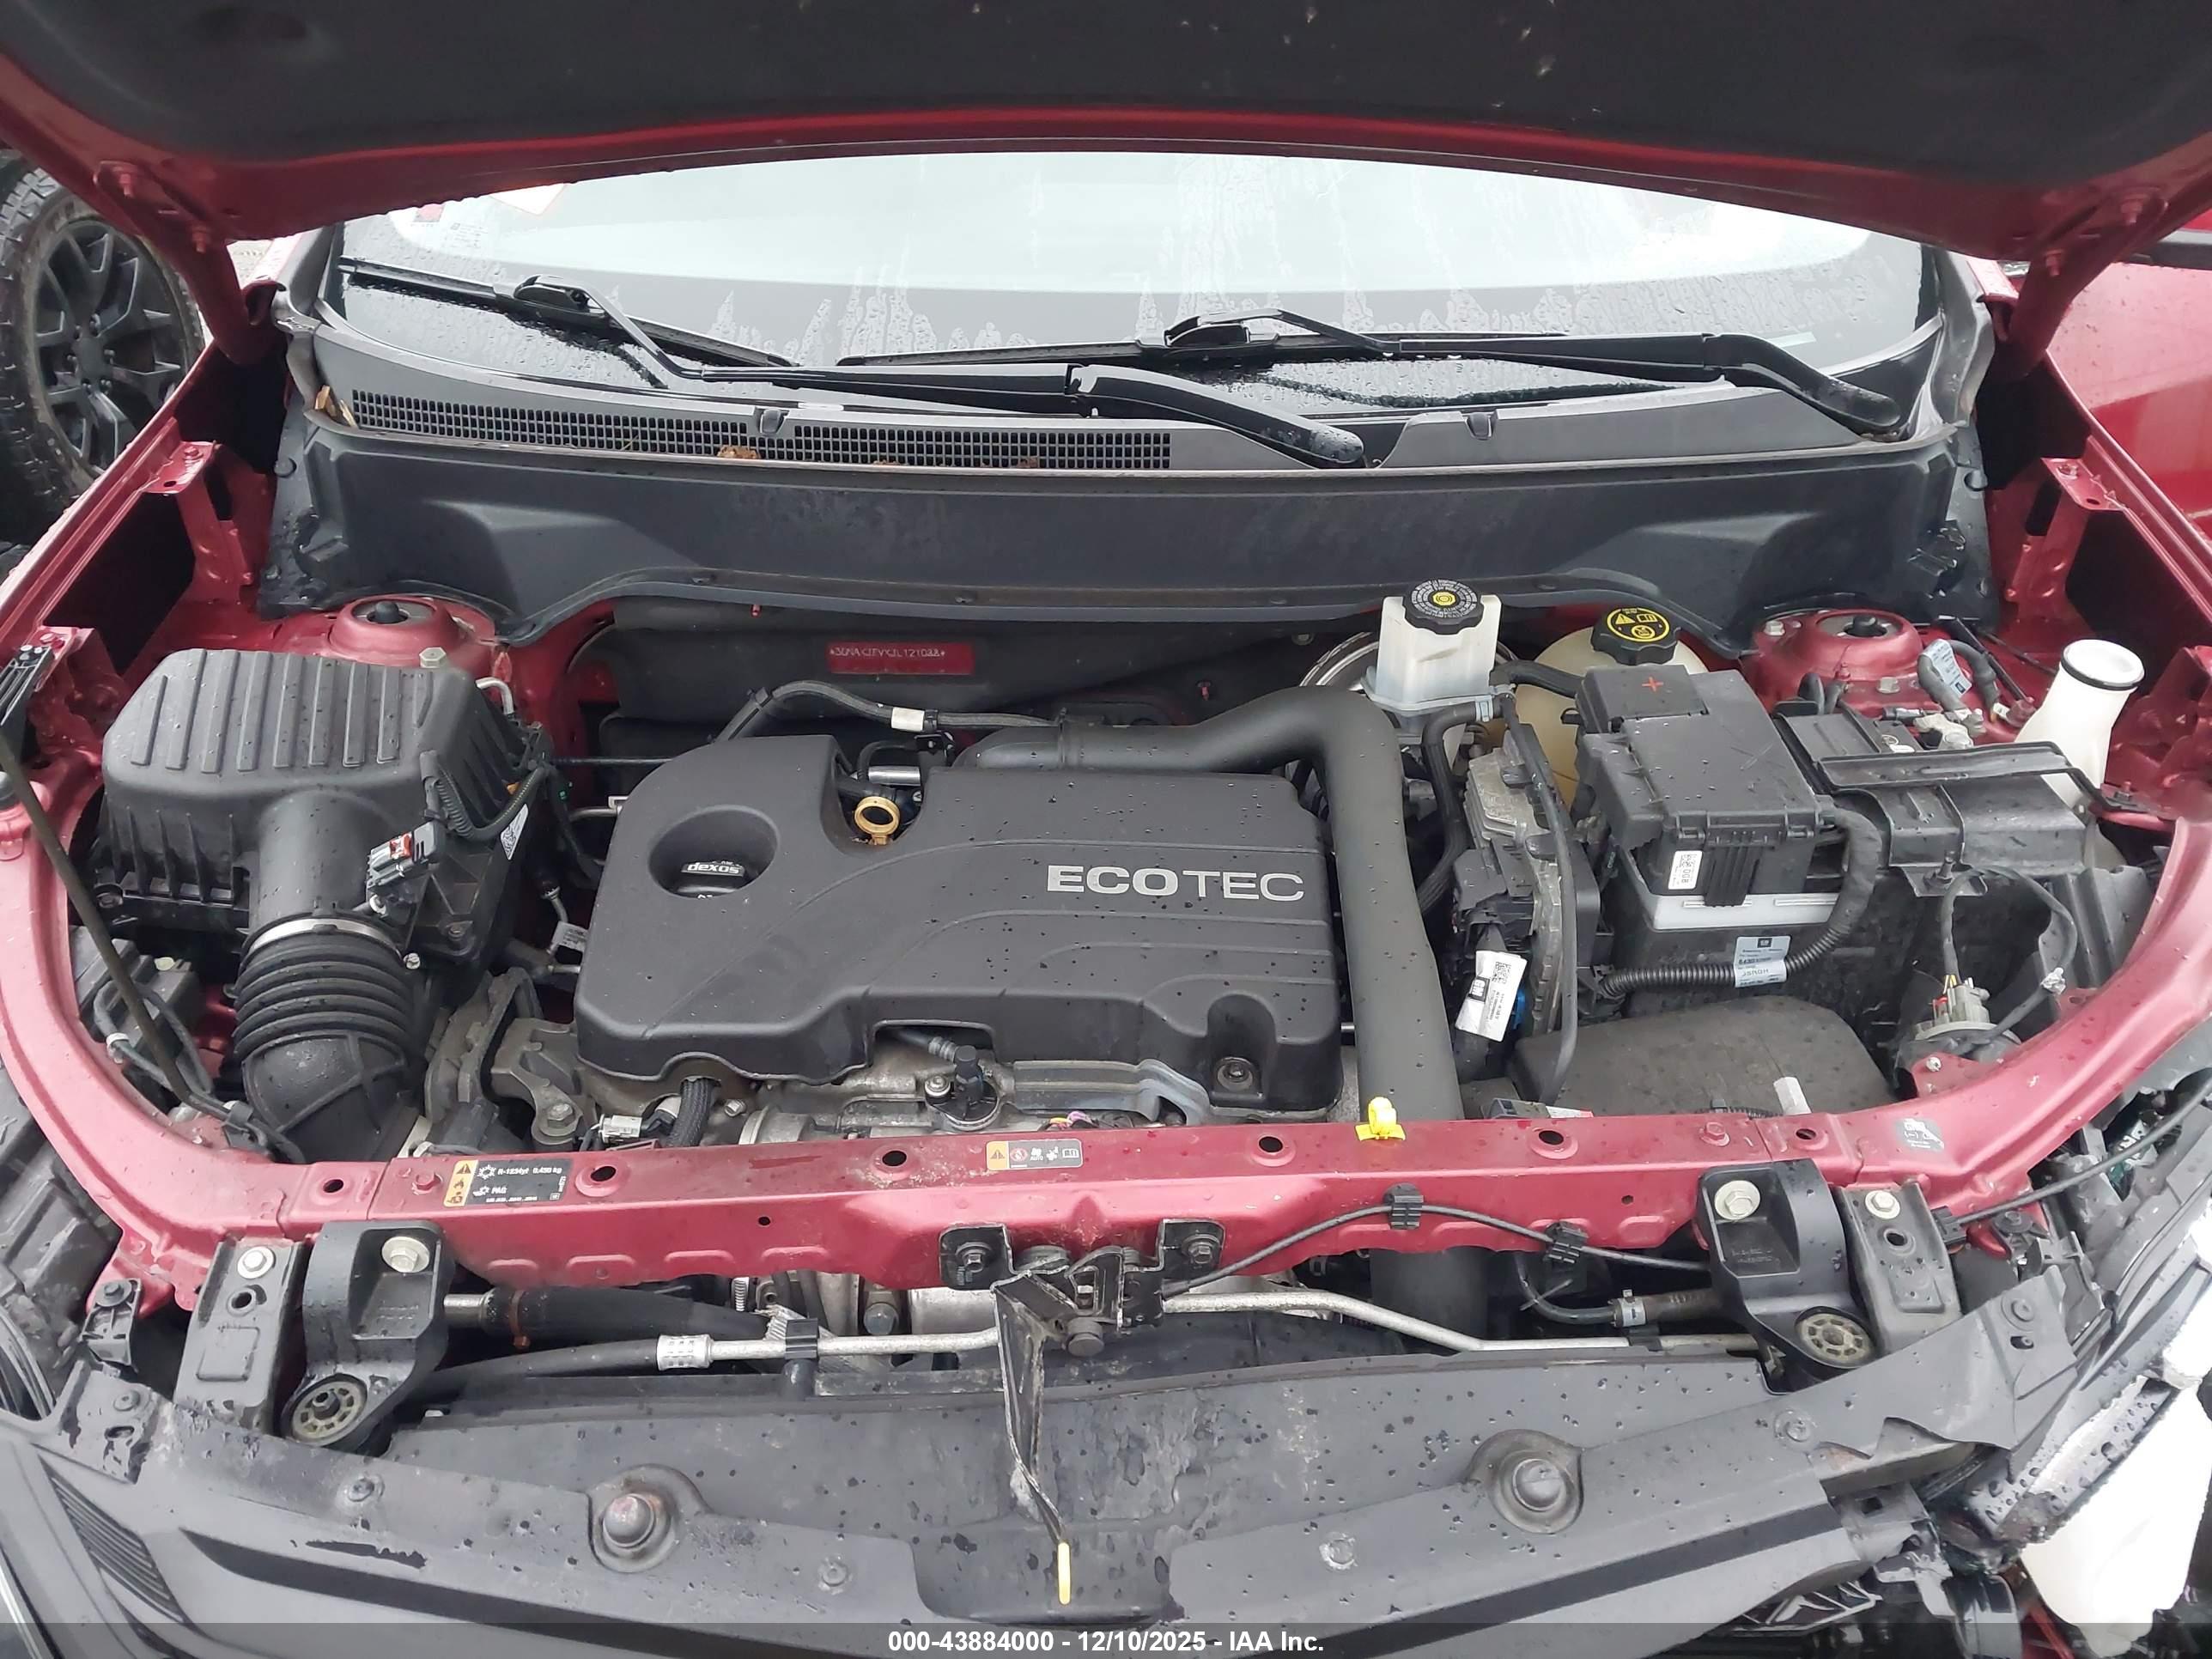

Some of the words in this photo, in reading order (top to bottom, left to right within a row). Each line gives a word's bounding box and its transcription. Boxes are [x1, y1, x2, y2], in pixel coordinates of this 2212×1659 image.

[687, 862, 739, 874] dexos
[1048, 866, 1304, 901] ECOTEC
[1471, 979, 1486, 997] GM
